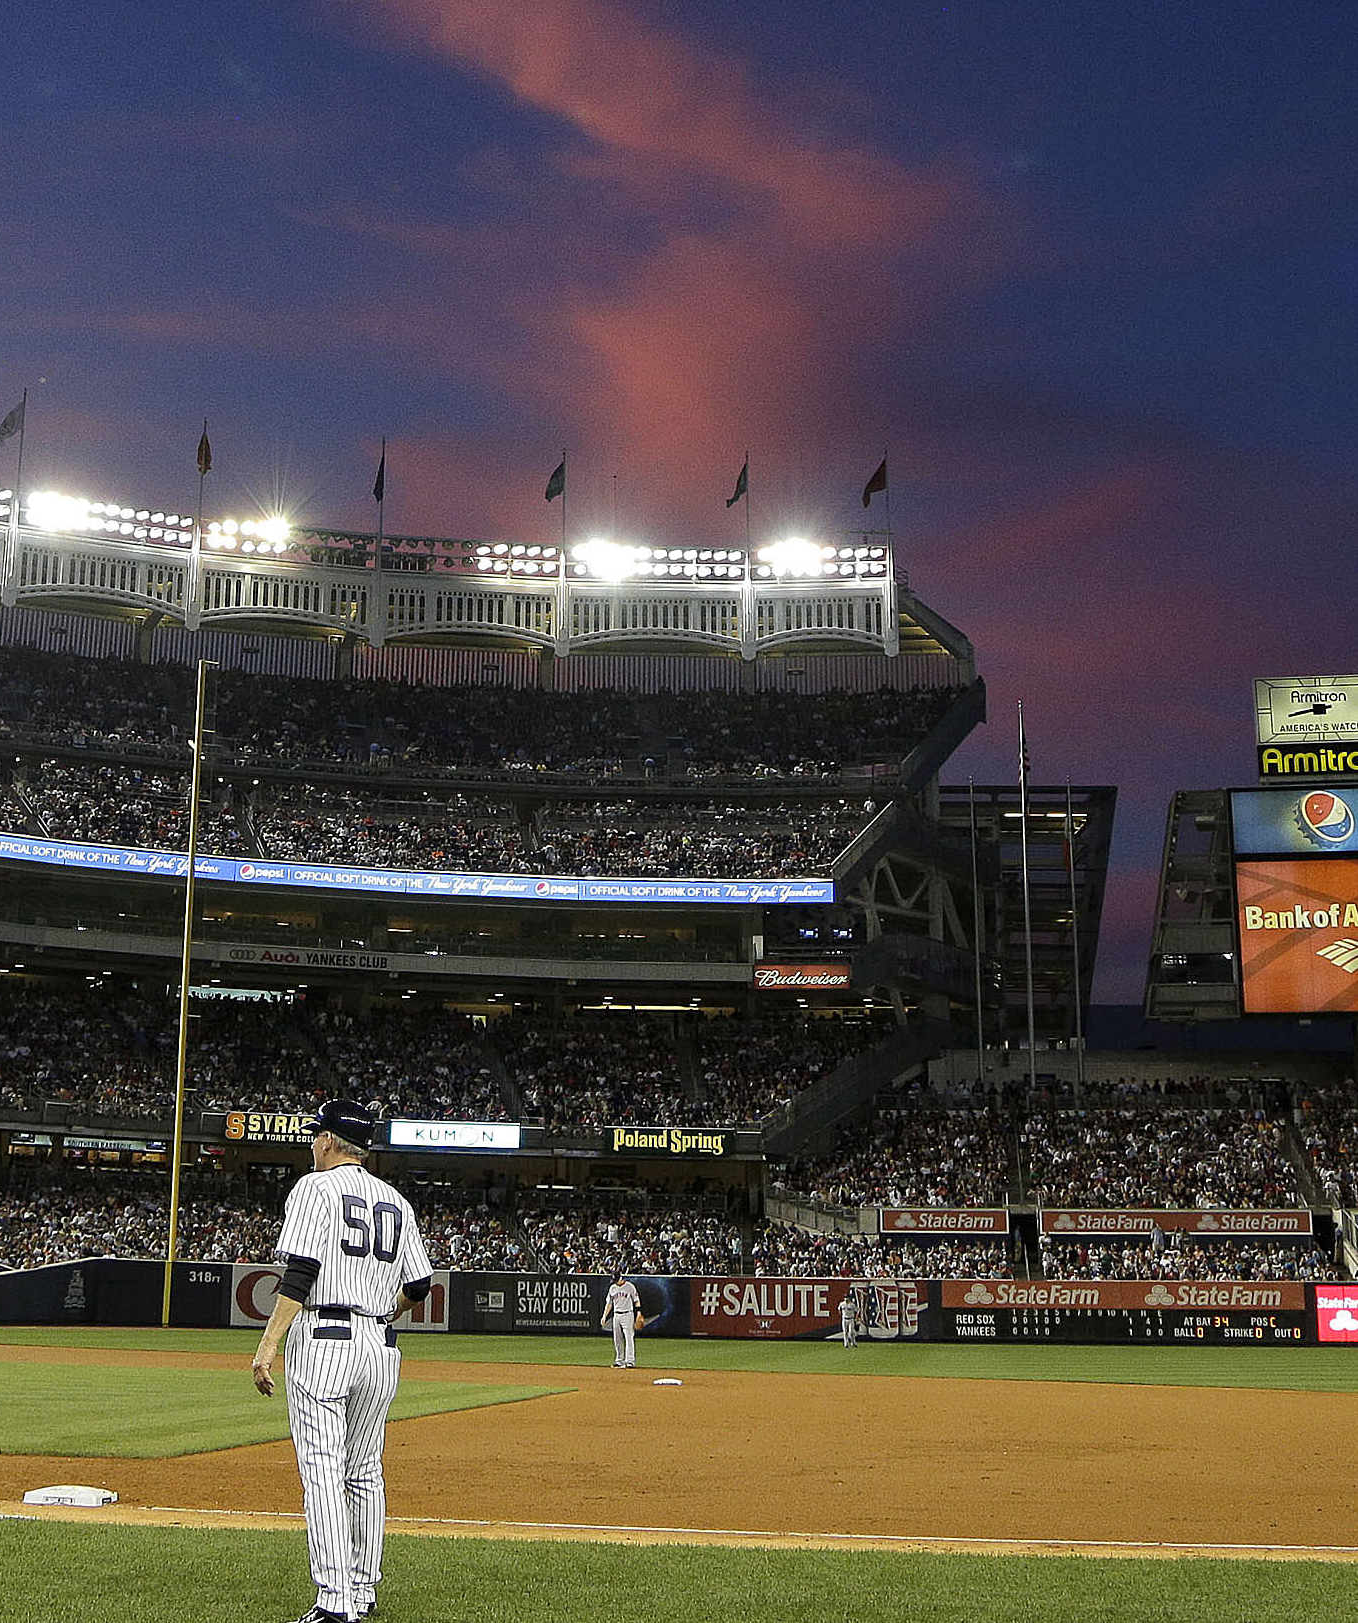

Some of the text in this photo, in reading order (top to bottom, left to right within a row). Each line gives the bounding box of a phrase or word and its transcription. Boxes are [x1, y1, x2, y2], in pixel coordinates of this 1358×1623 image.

[1291, 691, 1346, 703] Armitron
[1280, 723, 1358, 732] AMERICA'S WATC
[32, 845, 57, 858] SOFT
[57, 848, 86, 862] DRINK
[101, 854, 120, 865] THE
[123, 852, 147, 867] New
[143, 855, 178, 873] York
[254, 868, 284, 880] pepsi
[294, 870, 335, 883] OFFICIAL
[335, 874, 361, 886] SOFT
[361, 876, 389, 887] DRINK
[405, 878, 424, 889] THE
[425, 876, 452, 890] New
[450, 877, 482, 894] York
[480, 877, 529, 895] Yankees
[549, 884, 578, 896] pepsi
[589, 886, 631, 896] OFFICIAL
[631, 887, 657, 897] SOFT
[657, 887, 686, 897] DRINK
[702, 888, 721, 897] THE
[723, 884, 749, 897] New
[748, 885, 779, 902] York
[778, 885, 827, 902] Yankees
[1245, 904, 1312, 930] Bank
[1313, 903, 1340, 928] of
[260, 950, 388, 969] Audi YANKEES CLUB
[755, 970, 848, 987] Budweiser
[225, 1112, 245, 1139] S
[247, 1133, 264, 1141] NEW
[266, 1134, 294, 1142] YORK'S
[613, 1129, 724, 1155] Poland Spring
[341, 1195, 402, 1263] 50
[517, 1281, 549, 1298] PLAY
[553, 1282, 591, 1299] HARD.
[519, 1298, 548, 1315] STAY
[553, 1299, 589, 1315] COOL.
[701, 1283, 830, 1317] #SALUTE
[956, 1314, 974, 1325] RED
[976, 1314, 995, 1325] SOX
[1183, 1317, 1229, 1327] AT BAT 34
[1251, 1317, 1268, 1326] POS
[956, 1326, 996, 1336] YANKEES
[1174, 1329, 1195, 1338] BALL
[1224, 1329, 1254, 1338] STRIKE
[1275, 1329, 1292, 1338] OUT
